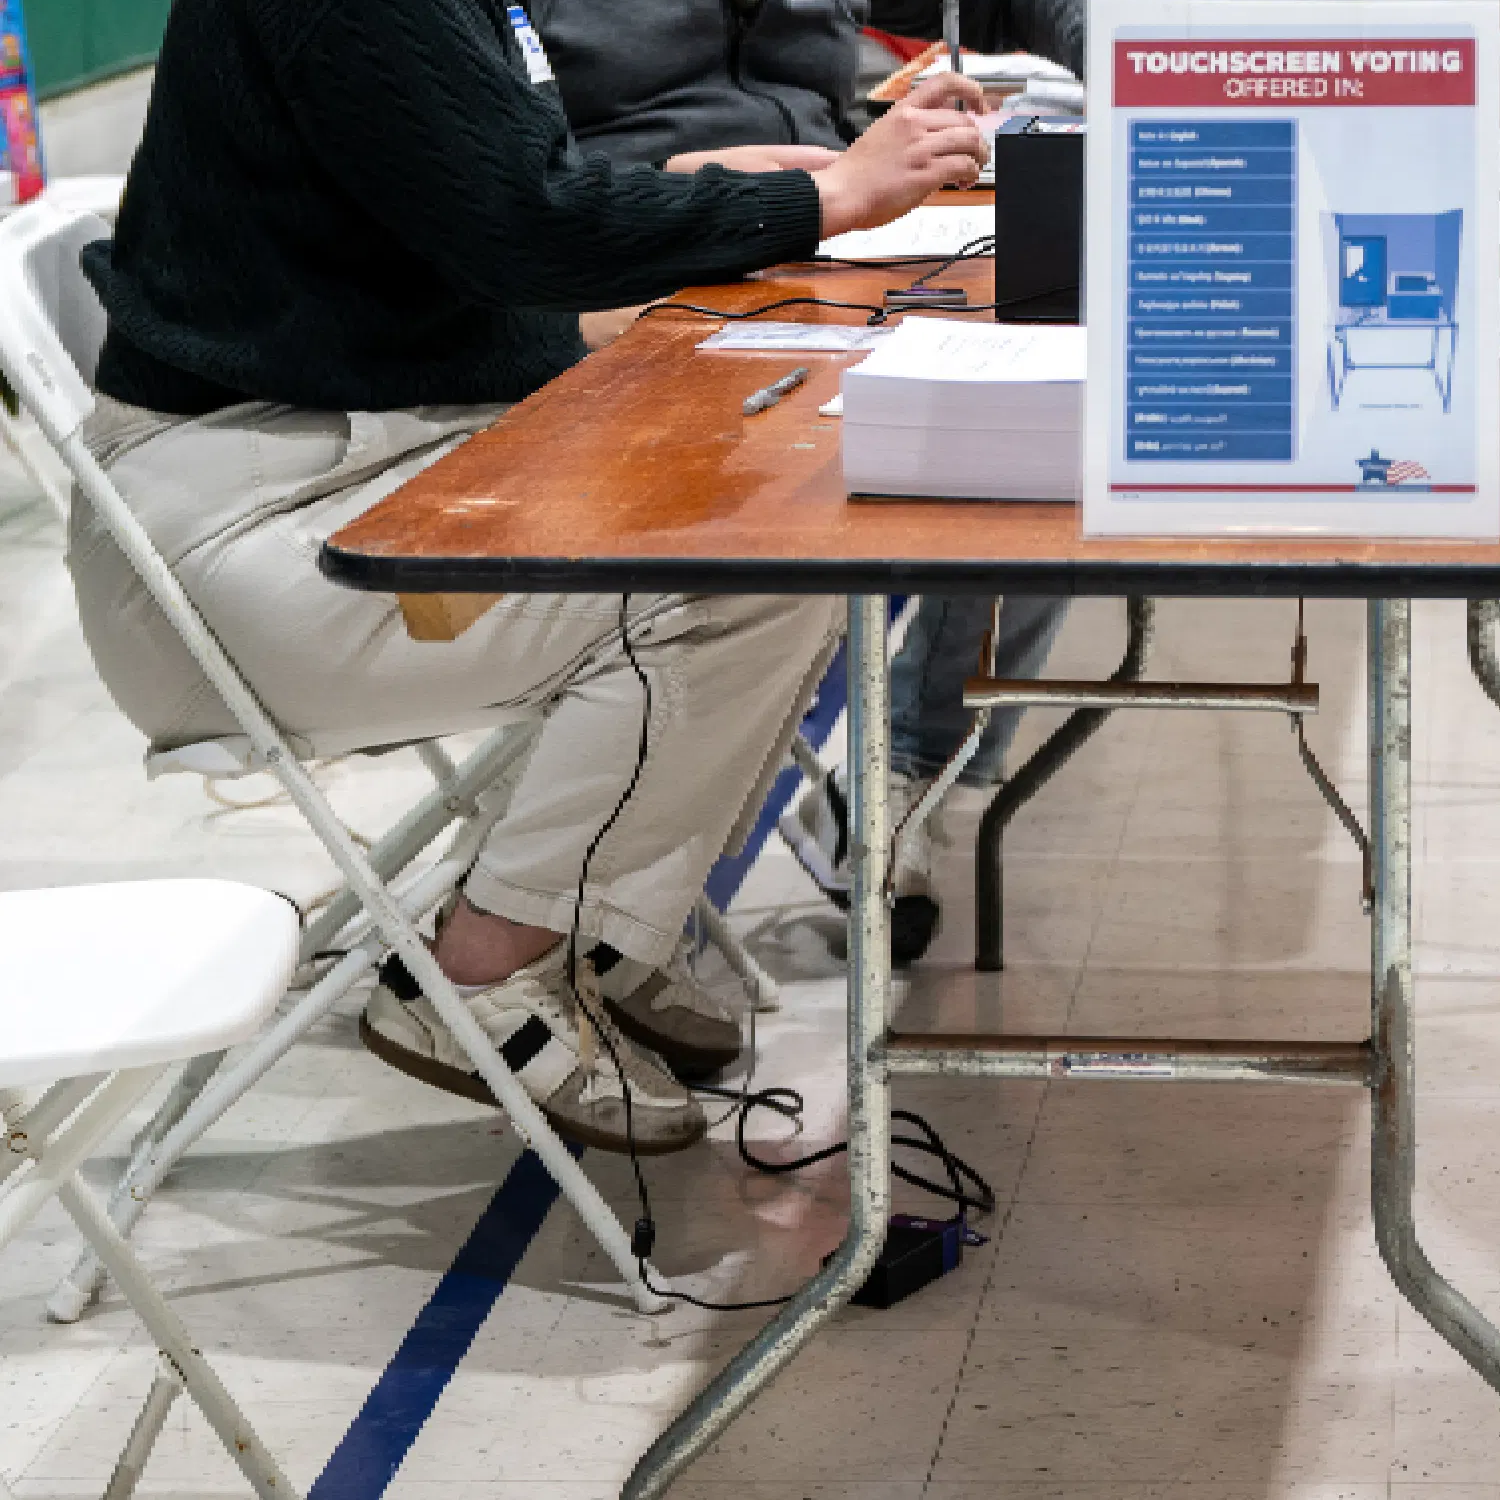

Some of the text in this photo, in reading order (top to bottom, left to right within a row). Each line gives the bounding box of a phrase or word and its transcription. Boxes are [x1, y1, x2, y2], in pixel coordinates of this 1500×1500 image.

[1128, 49, 1463, 74] TOUCHSCREEN VOTING
[1223, 78, 1364, 98] OFFERED IN:
